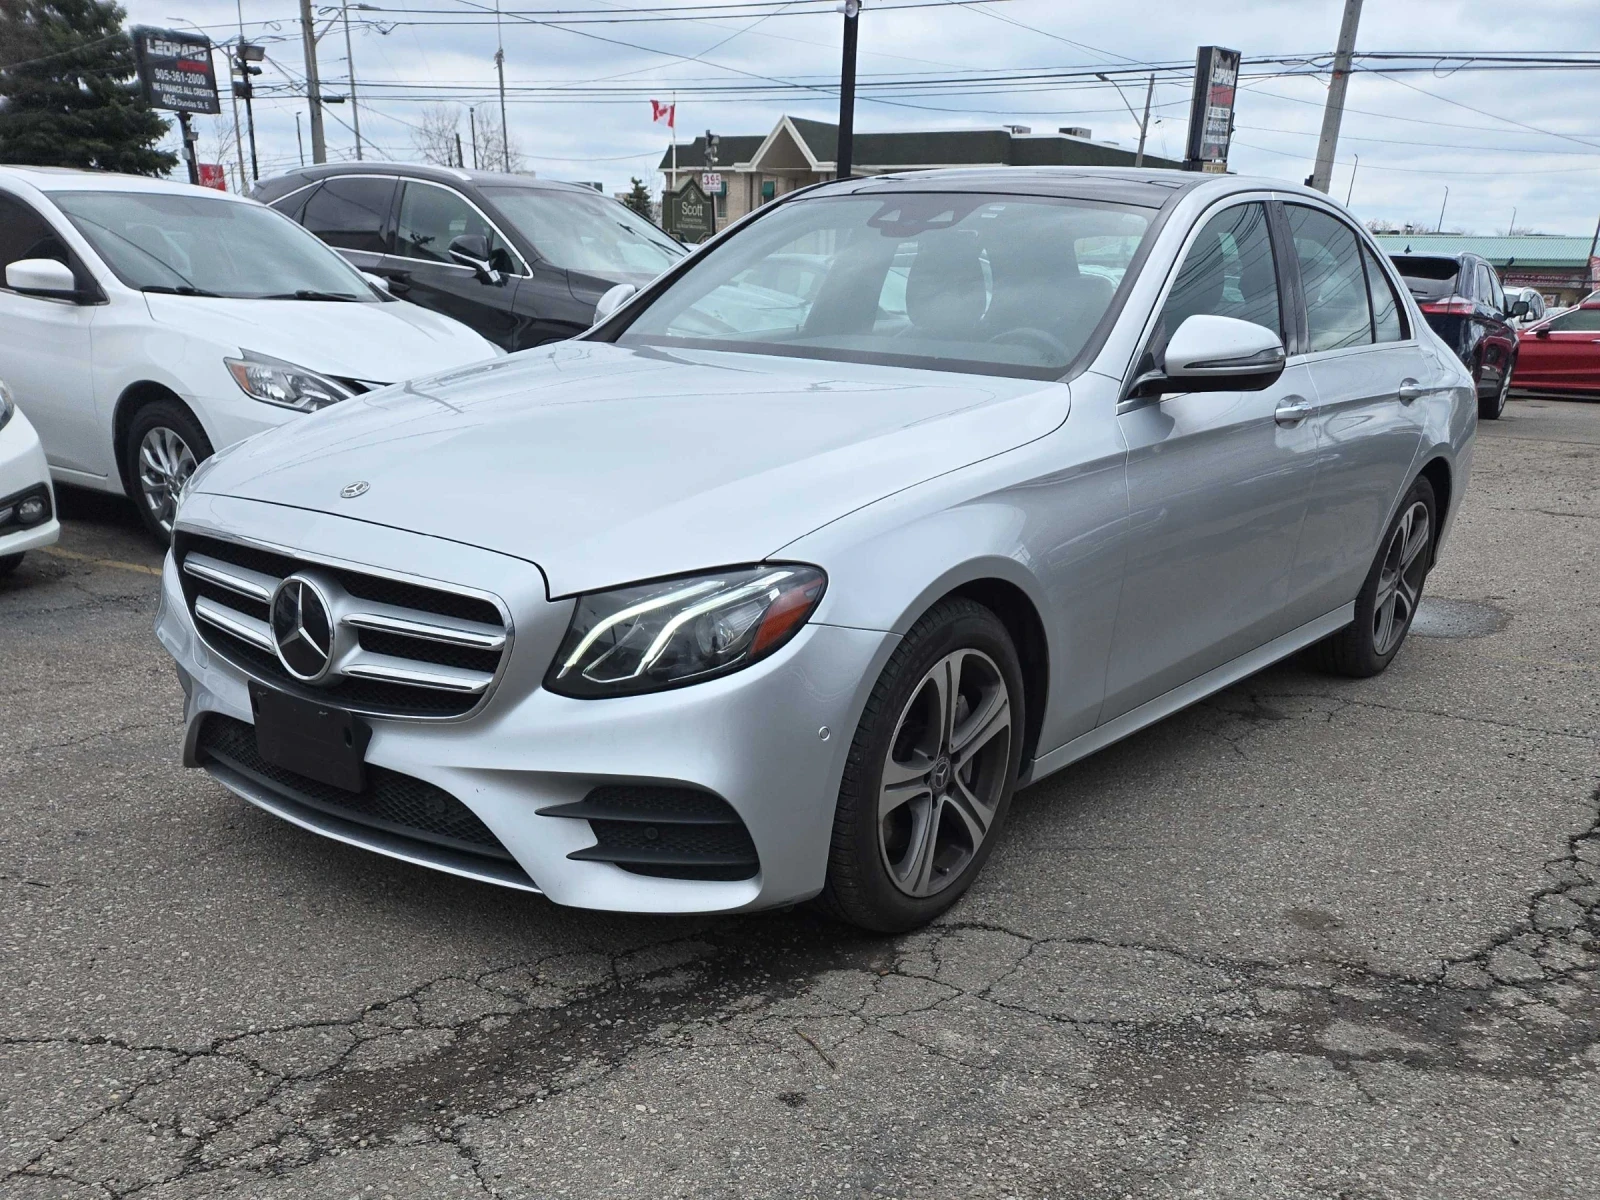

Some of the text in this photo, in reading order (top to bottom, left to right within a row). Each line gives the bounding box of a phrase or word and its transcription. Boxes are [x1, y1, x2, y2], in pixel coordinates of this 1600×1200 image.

[146, 38, 207, 61] LEOPARD
[154, 68, 206, 85] 905-361-2000
[161, 83, 183, 94] FINANCE
[184, 86, 193, 95] ALL
[193, 87, 215, 98] CREDITS
[162, 93, 177, 106] 405
[176, 99, 197, 108] Dundas
[703, 174, 721, 186] 395
[681, 201, 703, 217] Scott
